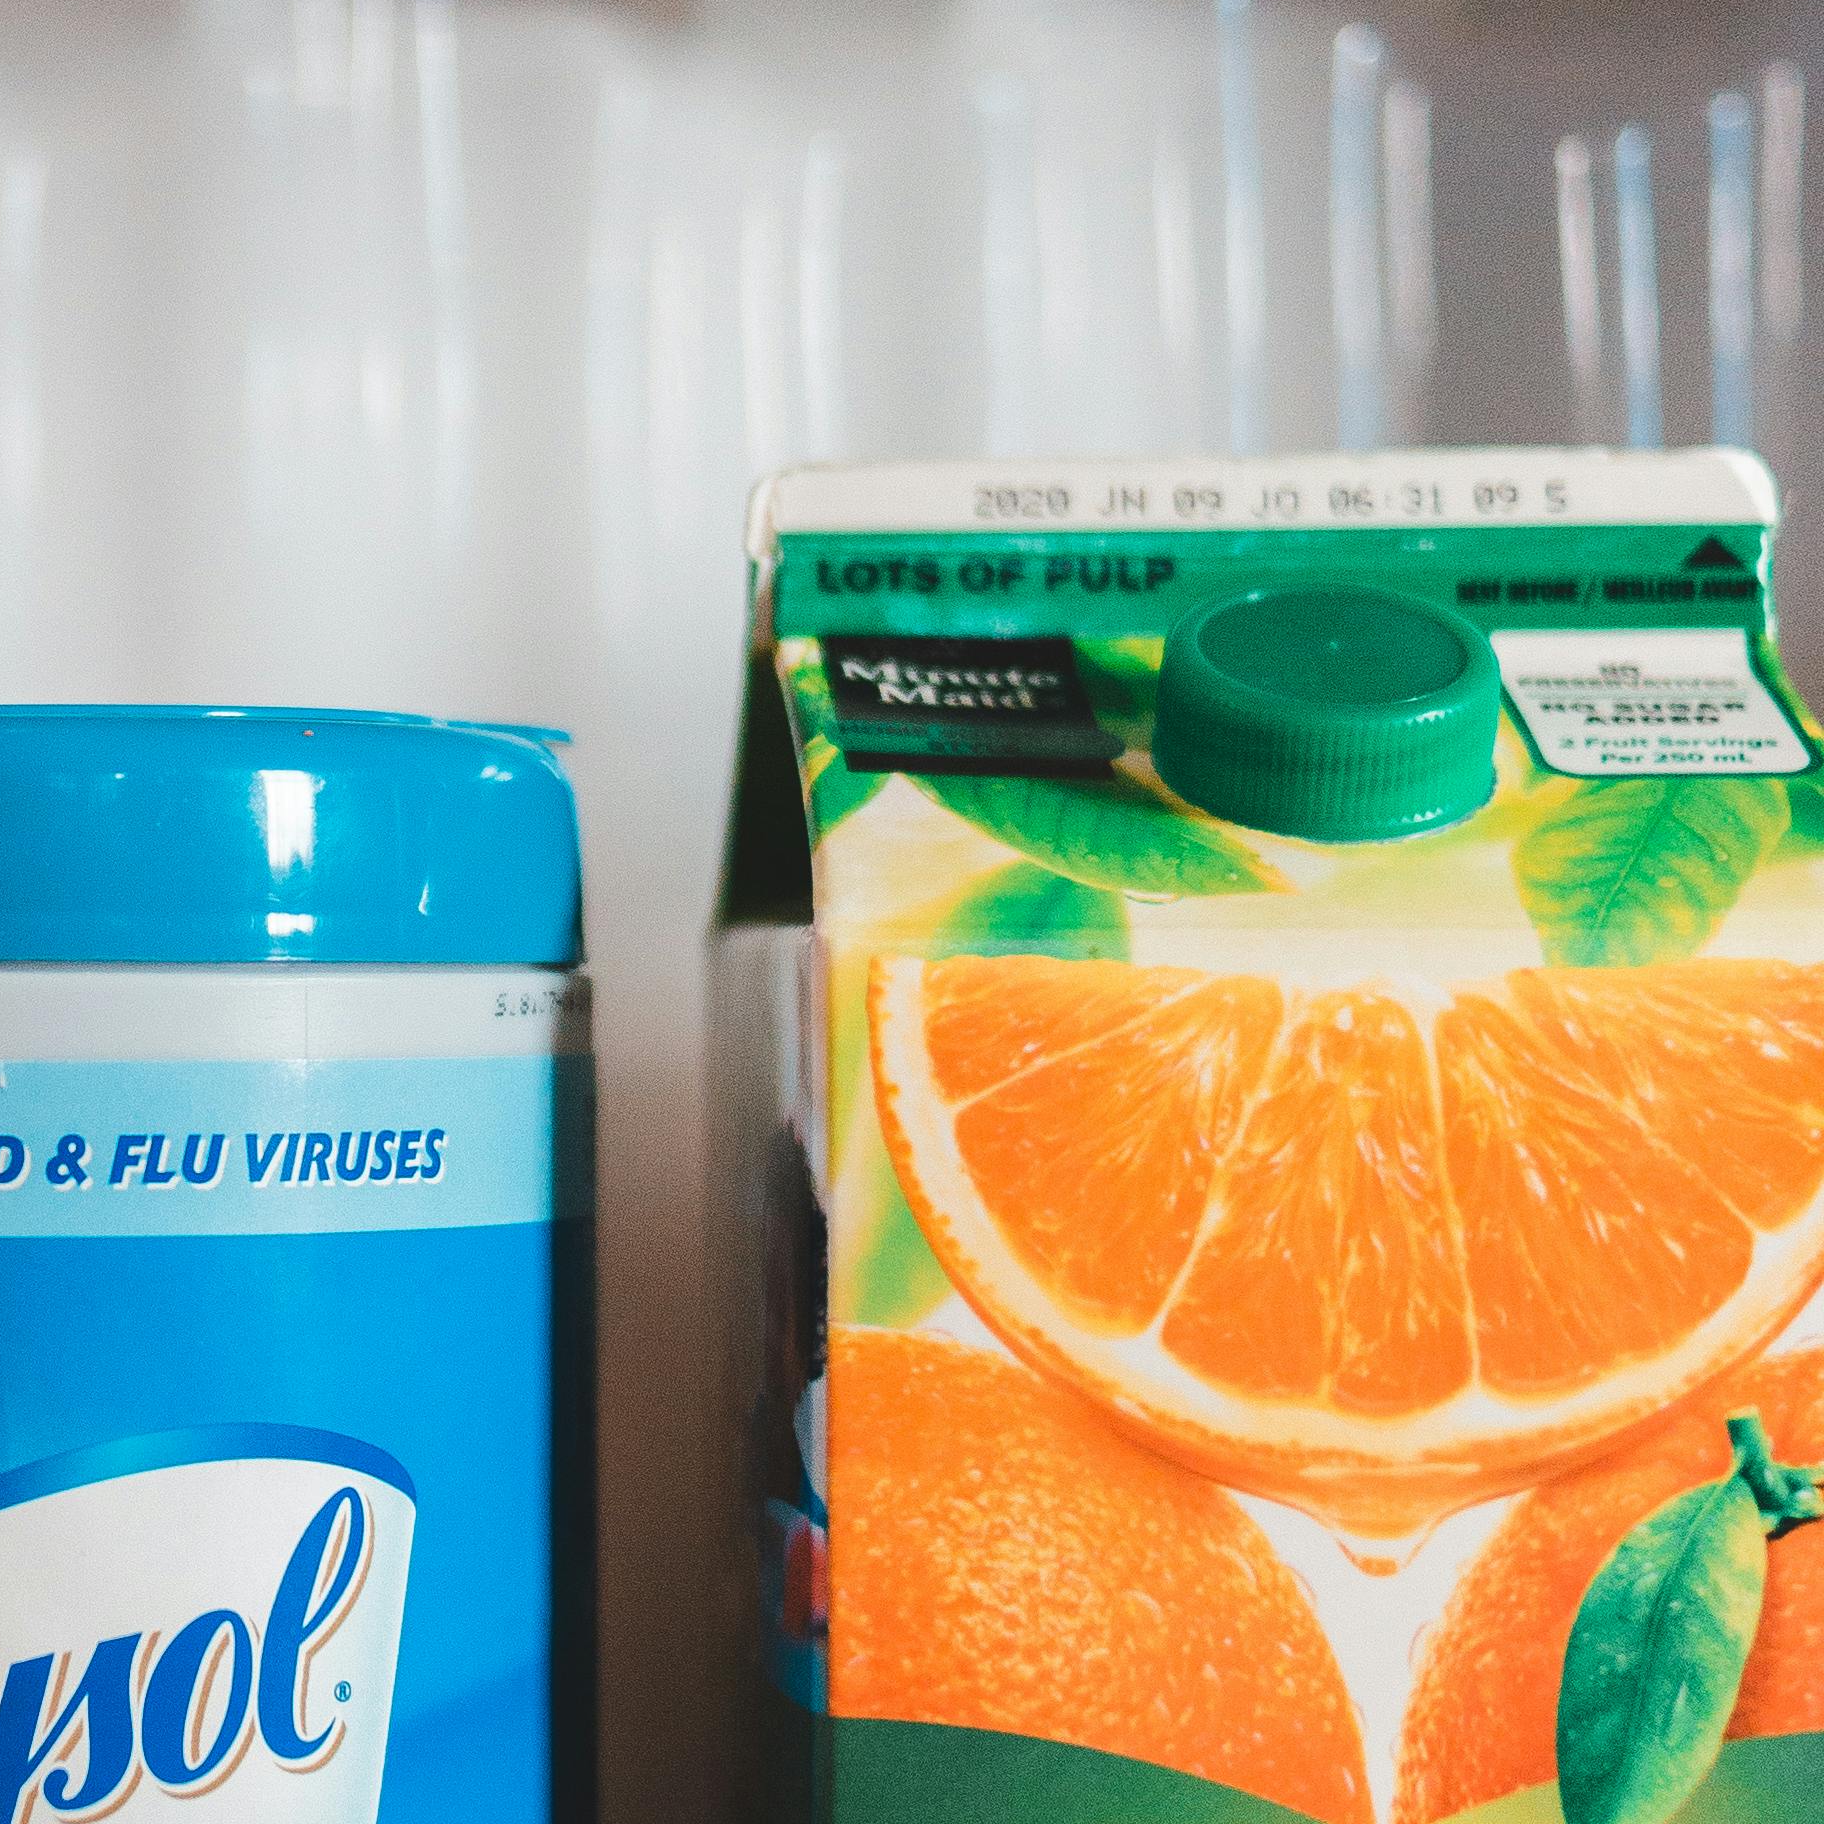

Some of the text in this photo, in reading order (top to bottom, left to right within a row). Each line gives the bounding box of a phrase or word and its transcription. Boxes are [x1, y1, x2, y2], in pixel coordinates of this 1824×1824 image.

[975, 484, 1073, 518] 2020
[1174, 483, 1224, 518] 09
[1473, 479, 1521, 516] 09
[816, 555, 1176, 595] LOTS OF PULP
[839, 654, 1062, 687] Minute
[876, 682, 1038, 709] Maid
[1612, 701, 1746, 713] SUGAR
[1584, 736, 1649, 749] Fruit
[1657, 736, 1778, 750] Servings
[1600, 753, 1643, 764] Per
[1654, 752, 1706, 764] 250
[45, 1132, 90, 1186] &
[108, 1132, 228, 1186] FLU
[245, 1127, 446, 1184] VIRUSES
